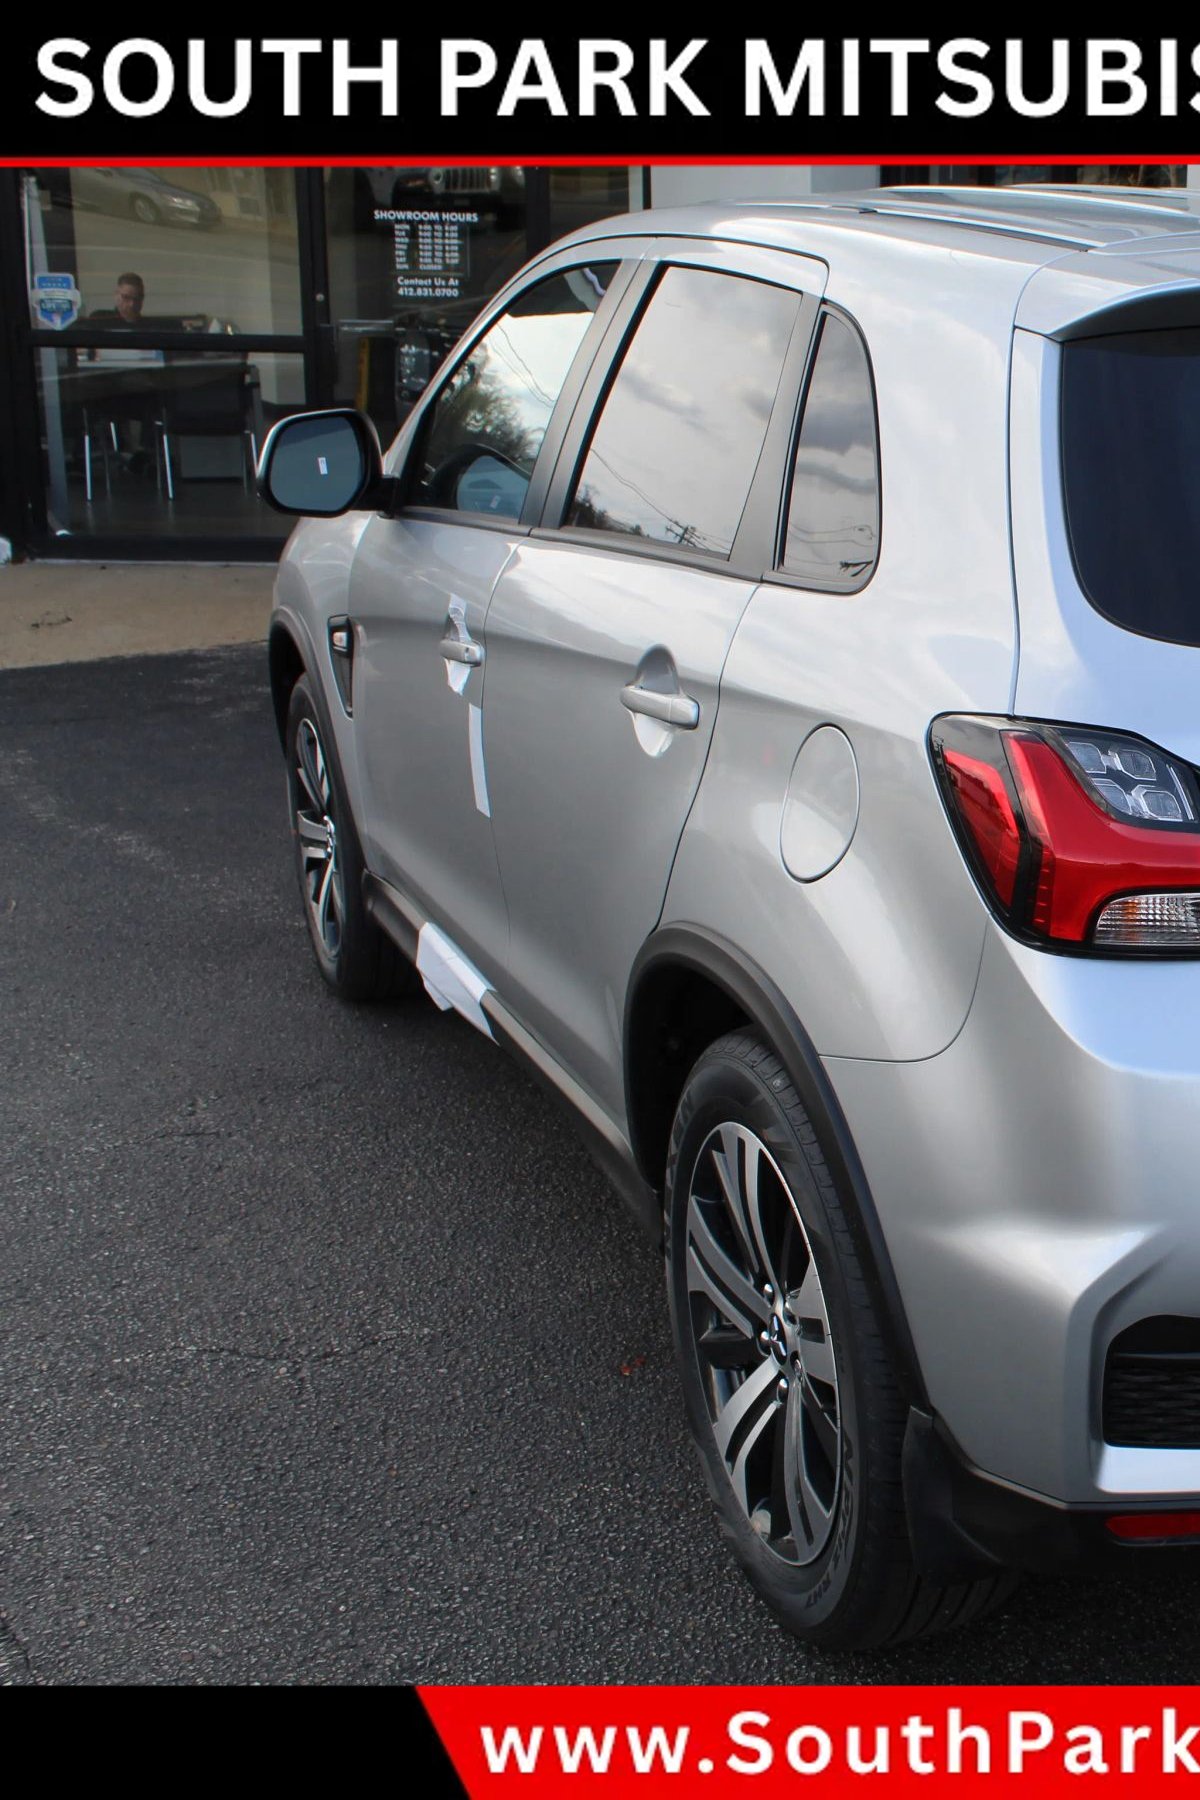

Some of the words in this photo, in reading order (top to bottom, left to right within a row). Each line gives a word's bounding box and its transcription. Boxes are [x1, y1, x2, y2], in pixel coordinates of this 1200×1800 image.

[374, 209, 439, 221] SHOWROOM
[442, 212, 479, 223] HOURS
[397, 276, 432, 286] Contact
[434, 277, 446, 286] Us
[448, 277, 459, 286] At
